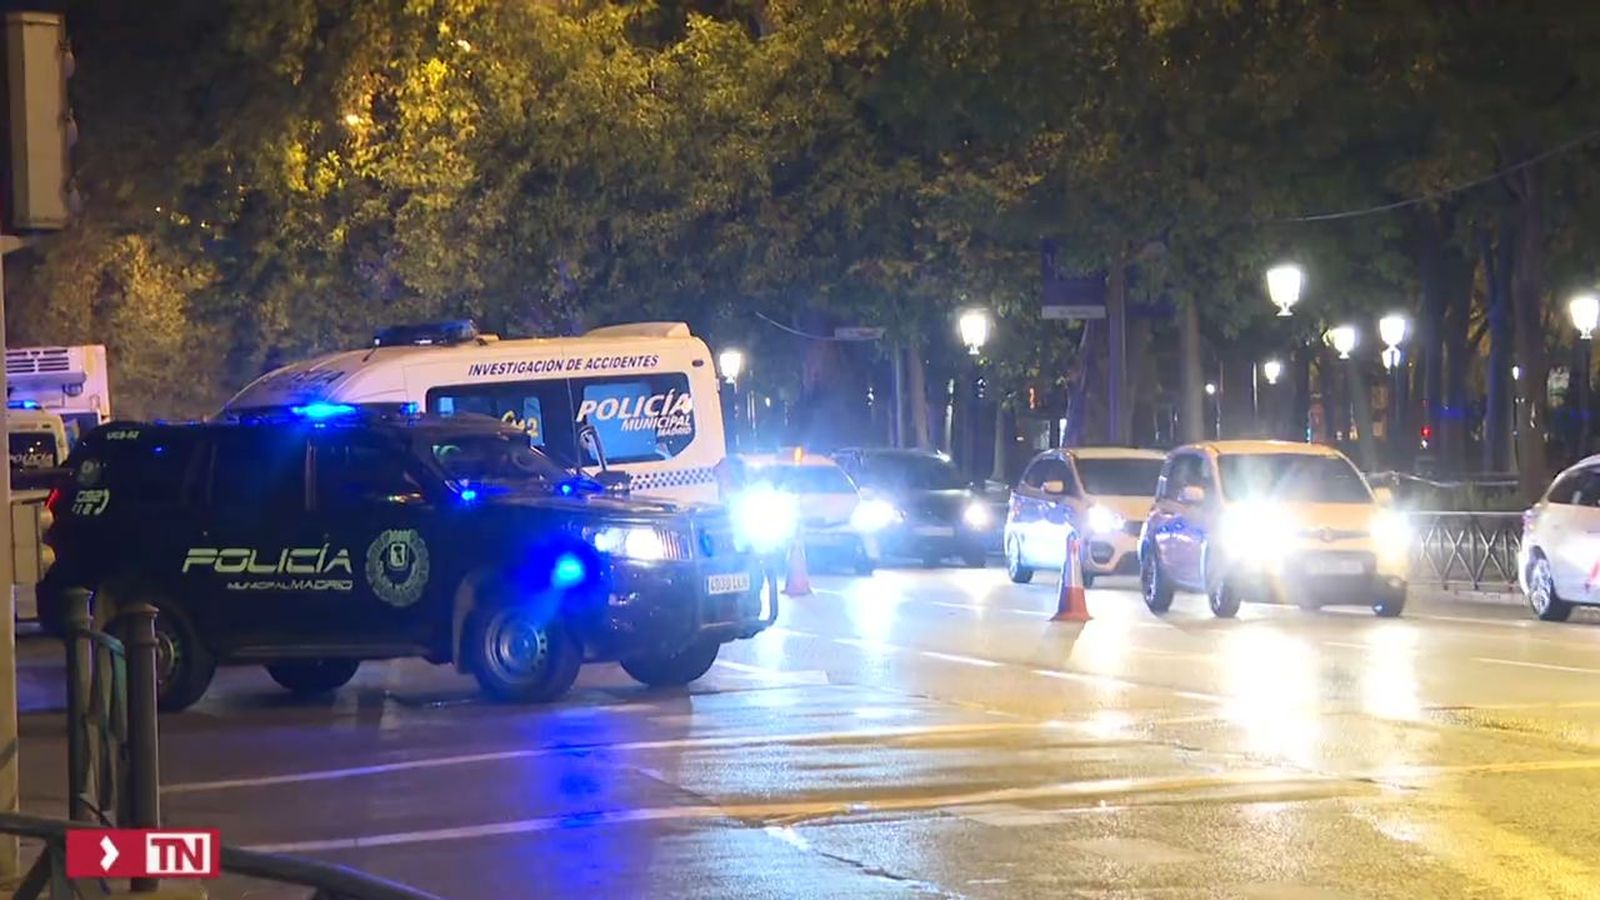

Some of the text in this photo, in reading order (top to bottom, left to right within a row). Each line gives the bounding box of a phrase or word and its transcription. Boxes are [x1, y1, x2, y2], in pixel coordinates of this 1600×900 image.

[566, 359, 583, 371] DE
[585, 354, 660, 370] ACCIDENTES
[576, 388, 693, 422] POLICÍA
[621, 415, 691, 432] MUNICIPAL
[182, 543, 352, 573] POLICÍA
